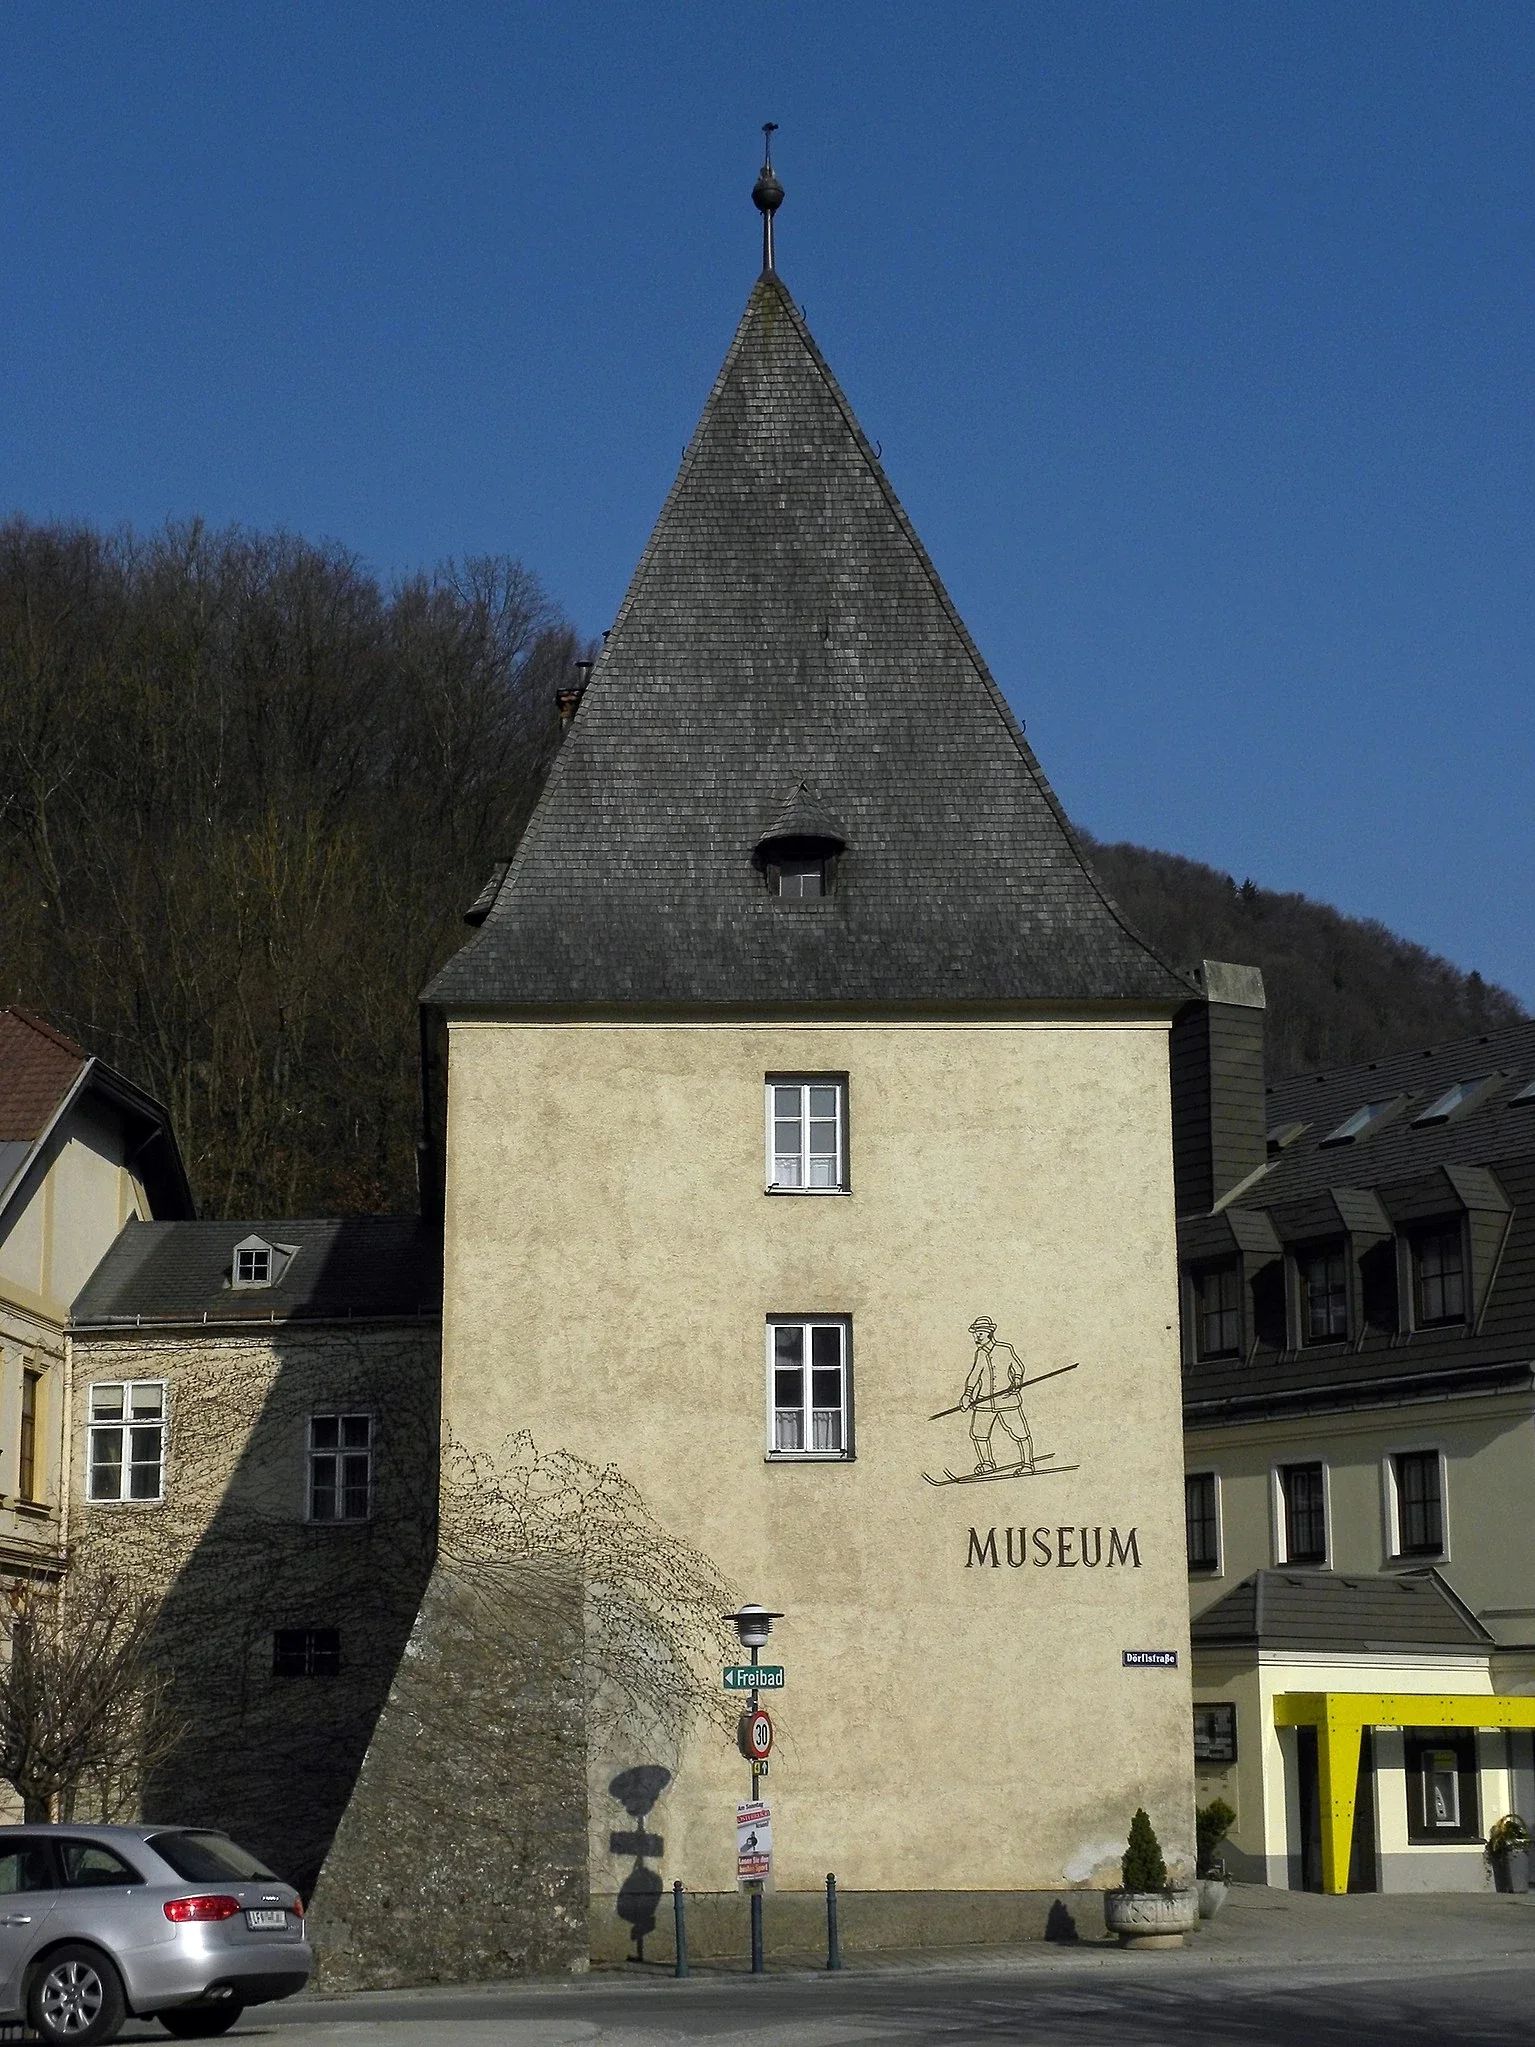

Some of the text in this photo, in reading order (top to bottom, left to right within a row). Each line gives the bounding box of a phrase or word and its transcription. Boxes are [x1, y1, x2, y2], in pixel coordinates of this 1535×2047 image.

[964, 1526, 1143, 1568] MUSEUM
[737, 1669, 783, 1686] Freibad
[756, 1724, 768, 1746] 30
[746, 1802, 764, 1810] Sonntag
